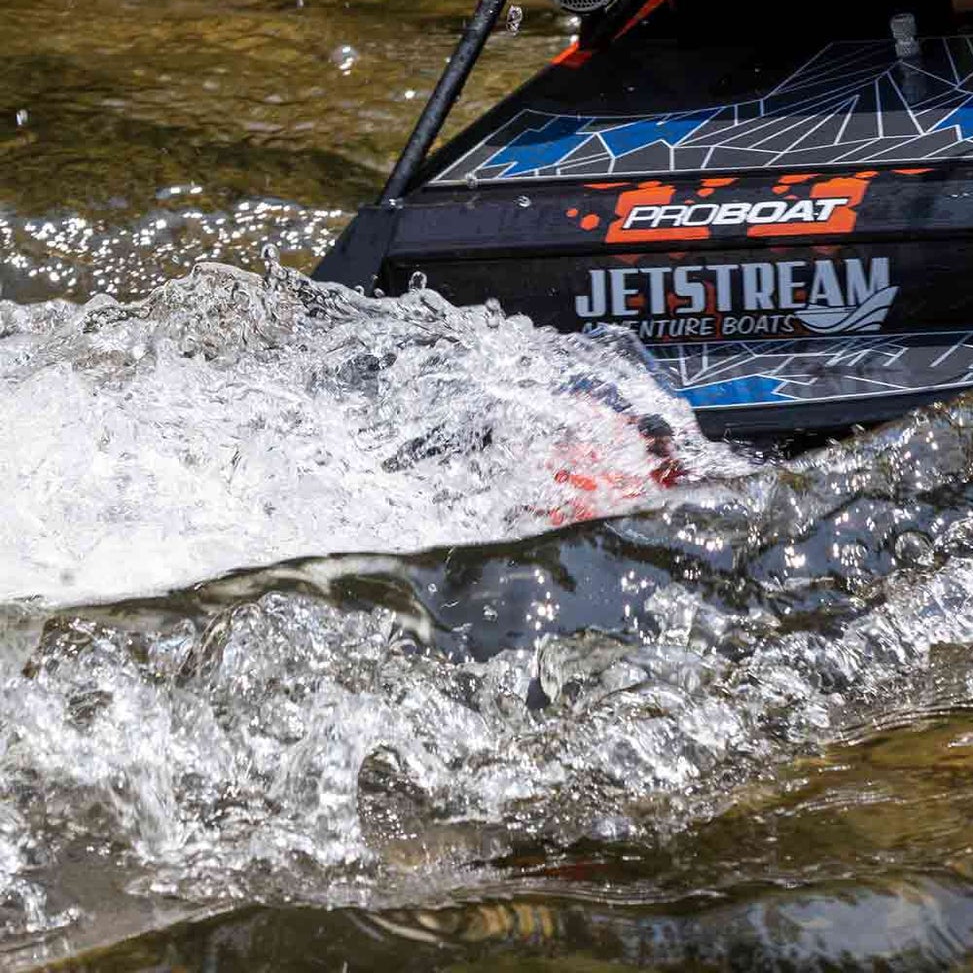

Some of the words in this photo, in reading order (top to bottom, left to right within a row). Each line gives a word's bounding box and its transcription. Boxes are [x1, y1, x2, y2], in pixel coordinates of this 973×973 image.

[622, 198, 848, 230] PROBOAT
[574, 256, 891, 318] JETSTREAM
[583, 315, 716, 340] ENTURE
[721, 313, 796, 336] BOATS
